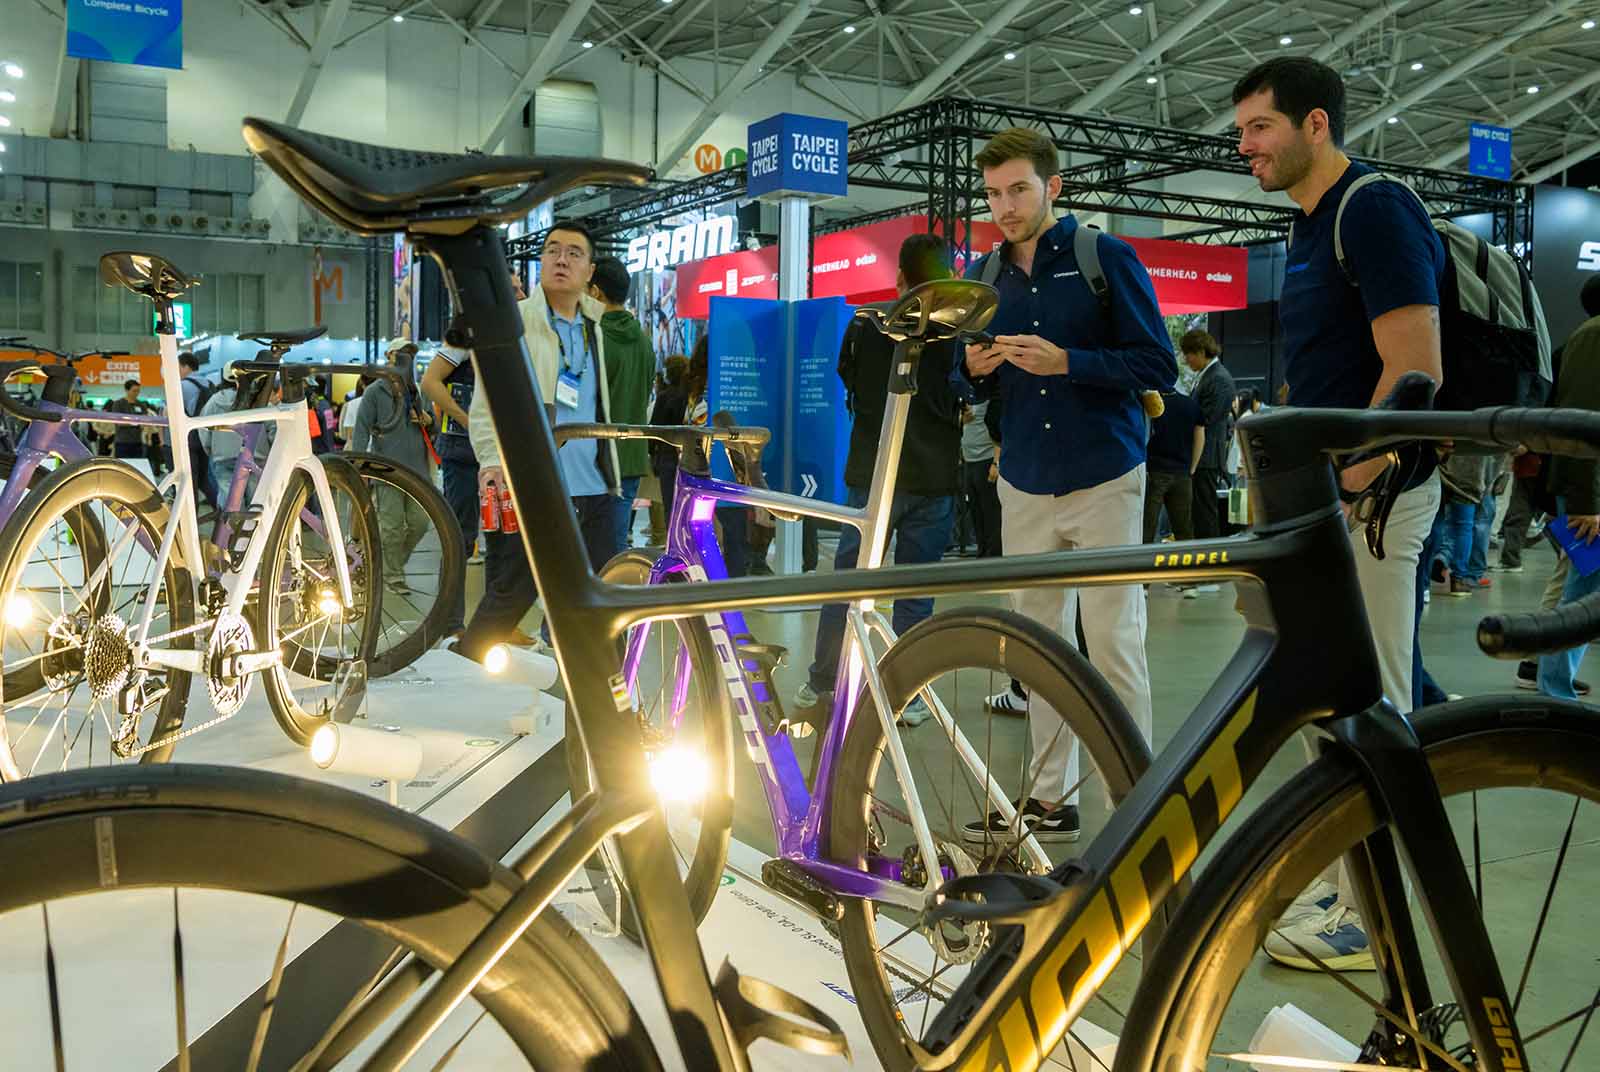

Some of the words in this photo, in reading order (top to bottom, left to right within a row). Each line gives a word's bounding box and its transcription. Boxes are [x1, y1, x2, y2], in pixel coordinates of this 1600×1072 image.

[134, 4, 169, 17] Bicycle
[752, 134, 779, 158] TAIPEI
[792, 133, 839, 155] TAIPEI
[1487, 144, 1496, 164] L
[700, 149, 717, 169] M
[752, 154, 778, 177] CYCLE
[792, 152, 839, 175] CYCLE
[626, 216, 736, 275] SRAM
[1153, 550, 1231, 567] PROPEL
[957, 687, 1258, 1072] IANT
[1481, 996, 1523, 1072] GIA
